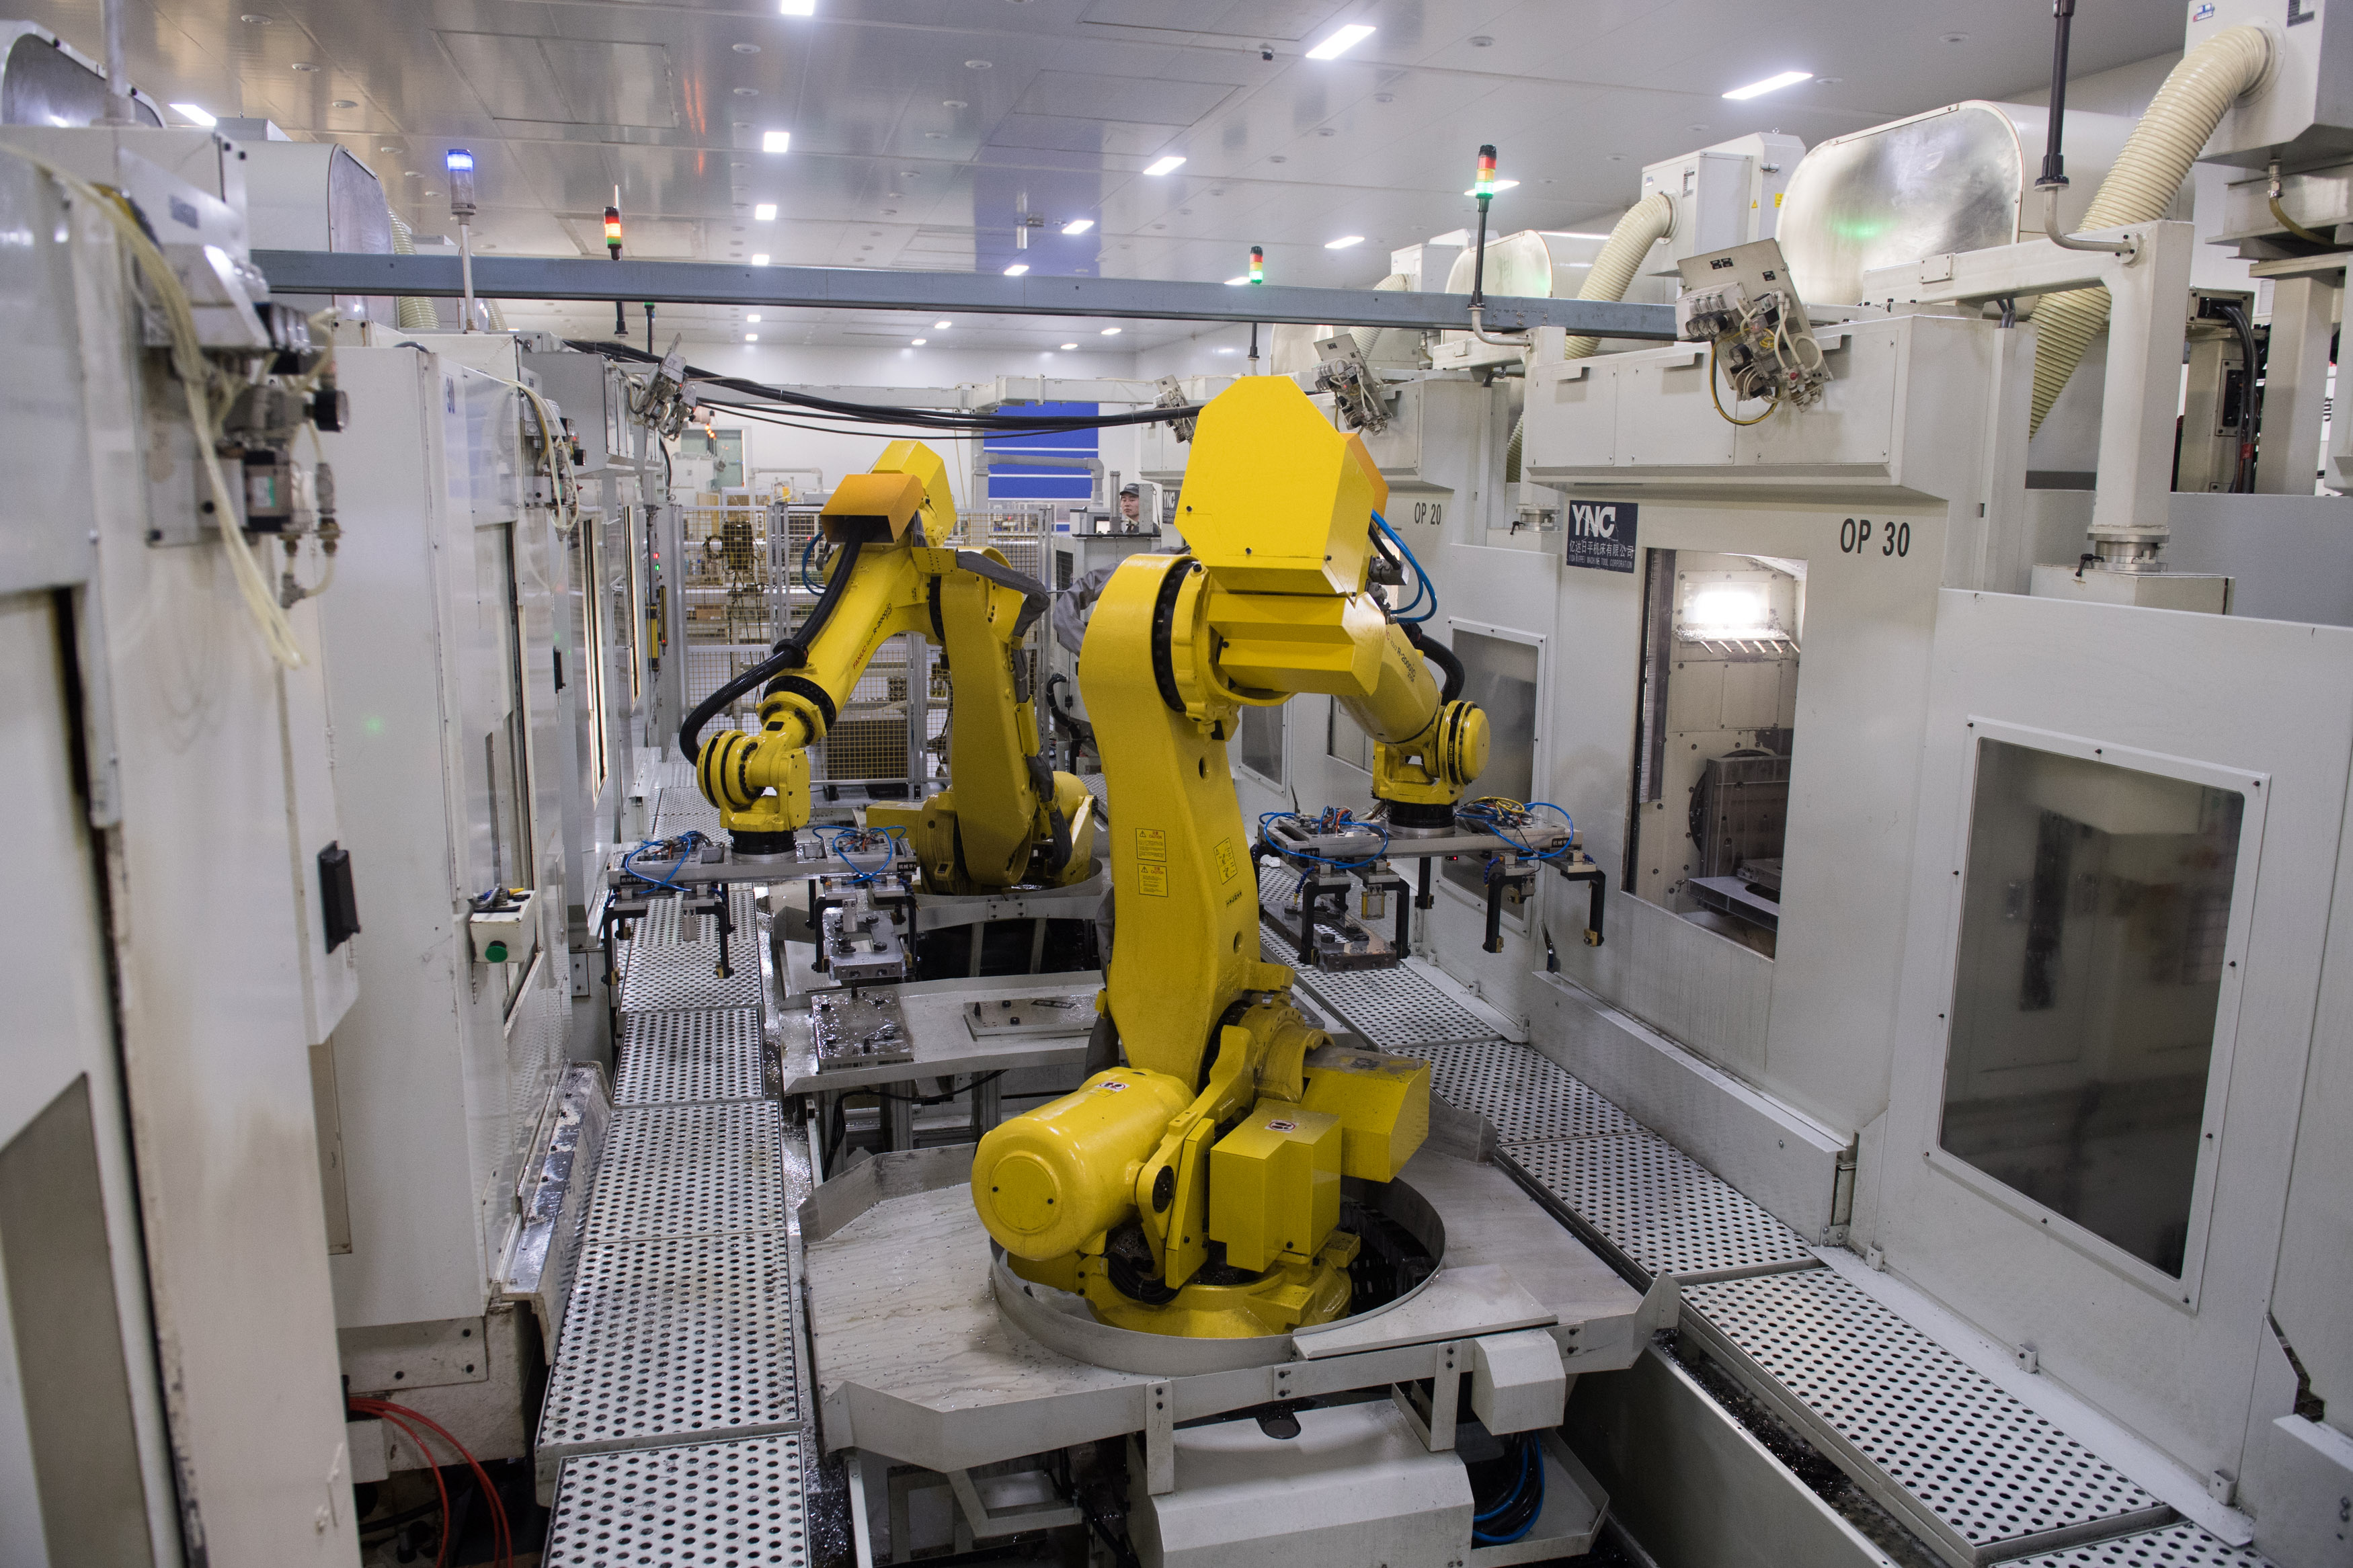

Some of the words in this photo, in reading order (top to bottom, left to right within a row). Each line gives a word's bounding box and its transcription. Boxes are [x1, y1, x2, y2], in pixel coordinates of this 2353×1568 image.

[1163, 491, 1175, 508] YNC
[1414, 502, 1427, 524] OP
[1431, 503, 1441, 525] 20
[1572, 505, 1616, 538] YNC
[1841, 518, 1871, 554] OP
[1882, 522, 1910, 557] 30
[1570, 540, 1634, 559] 亿达日平机床有限公司
[1601, 558, 1609, 567] TOOL
[1609, 559, 1632, 569] CORPORATION
[853, 645, 867, 669] FANUC
[1397, 647, 1416, 677] R-2000iC
